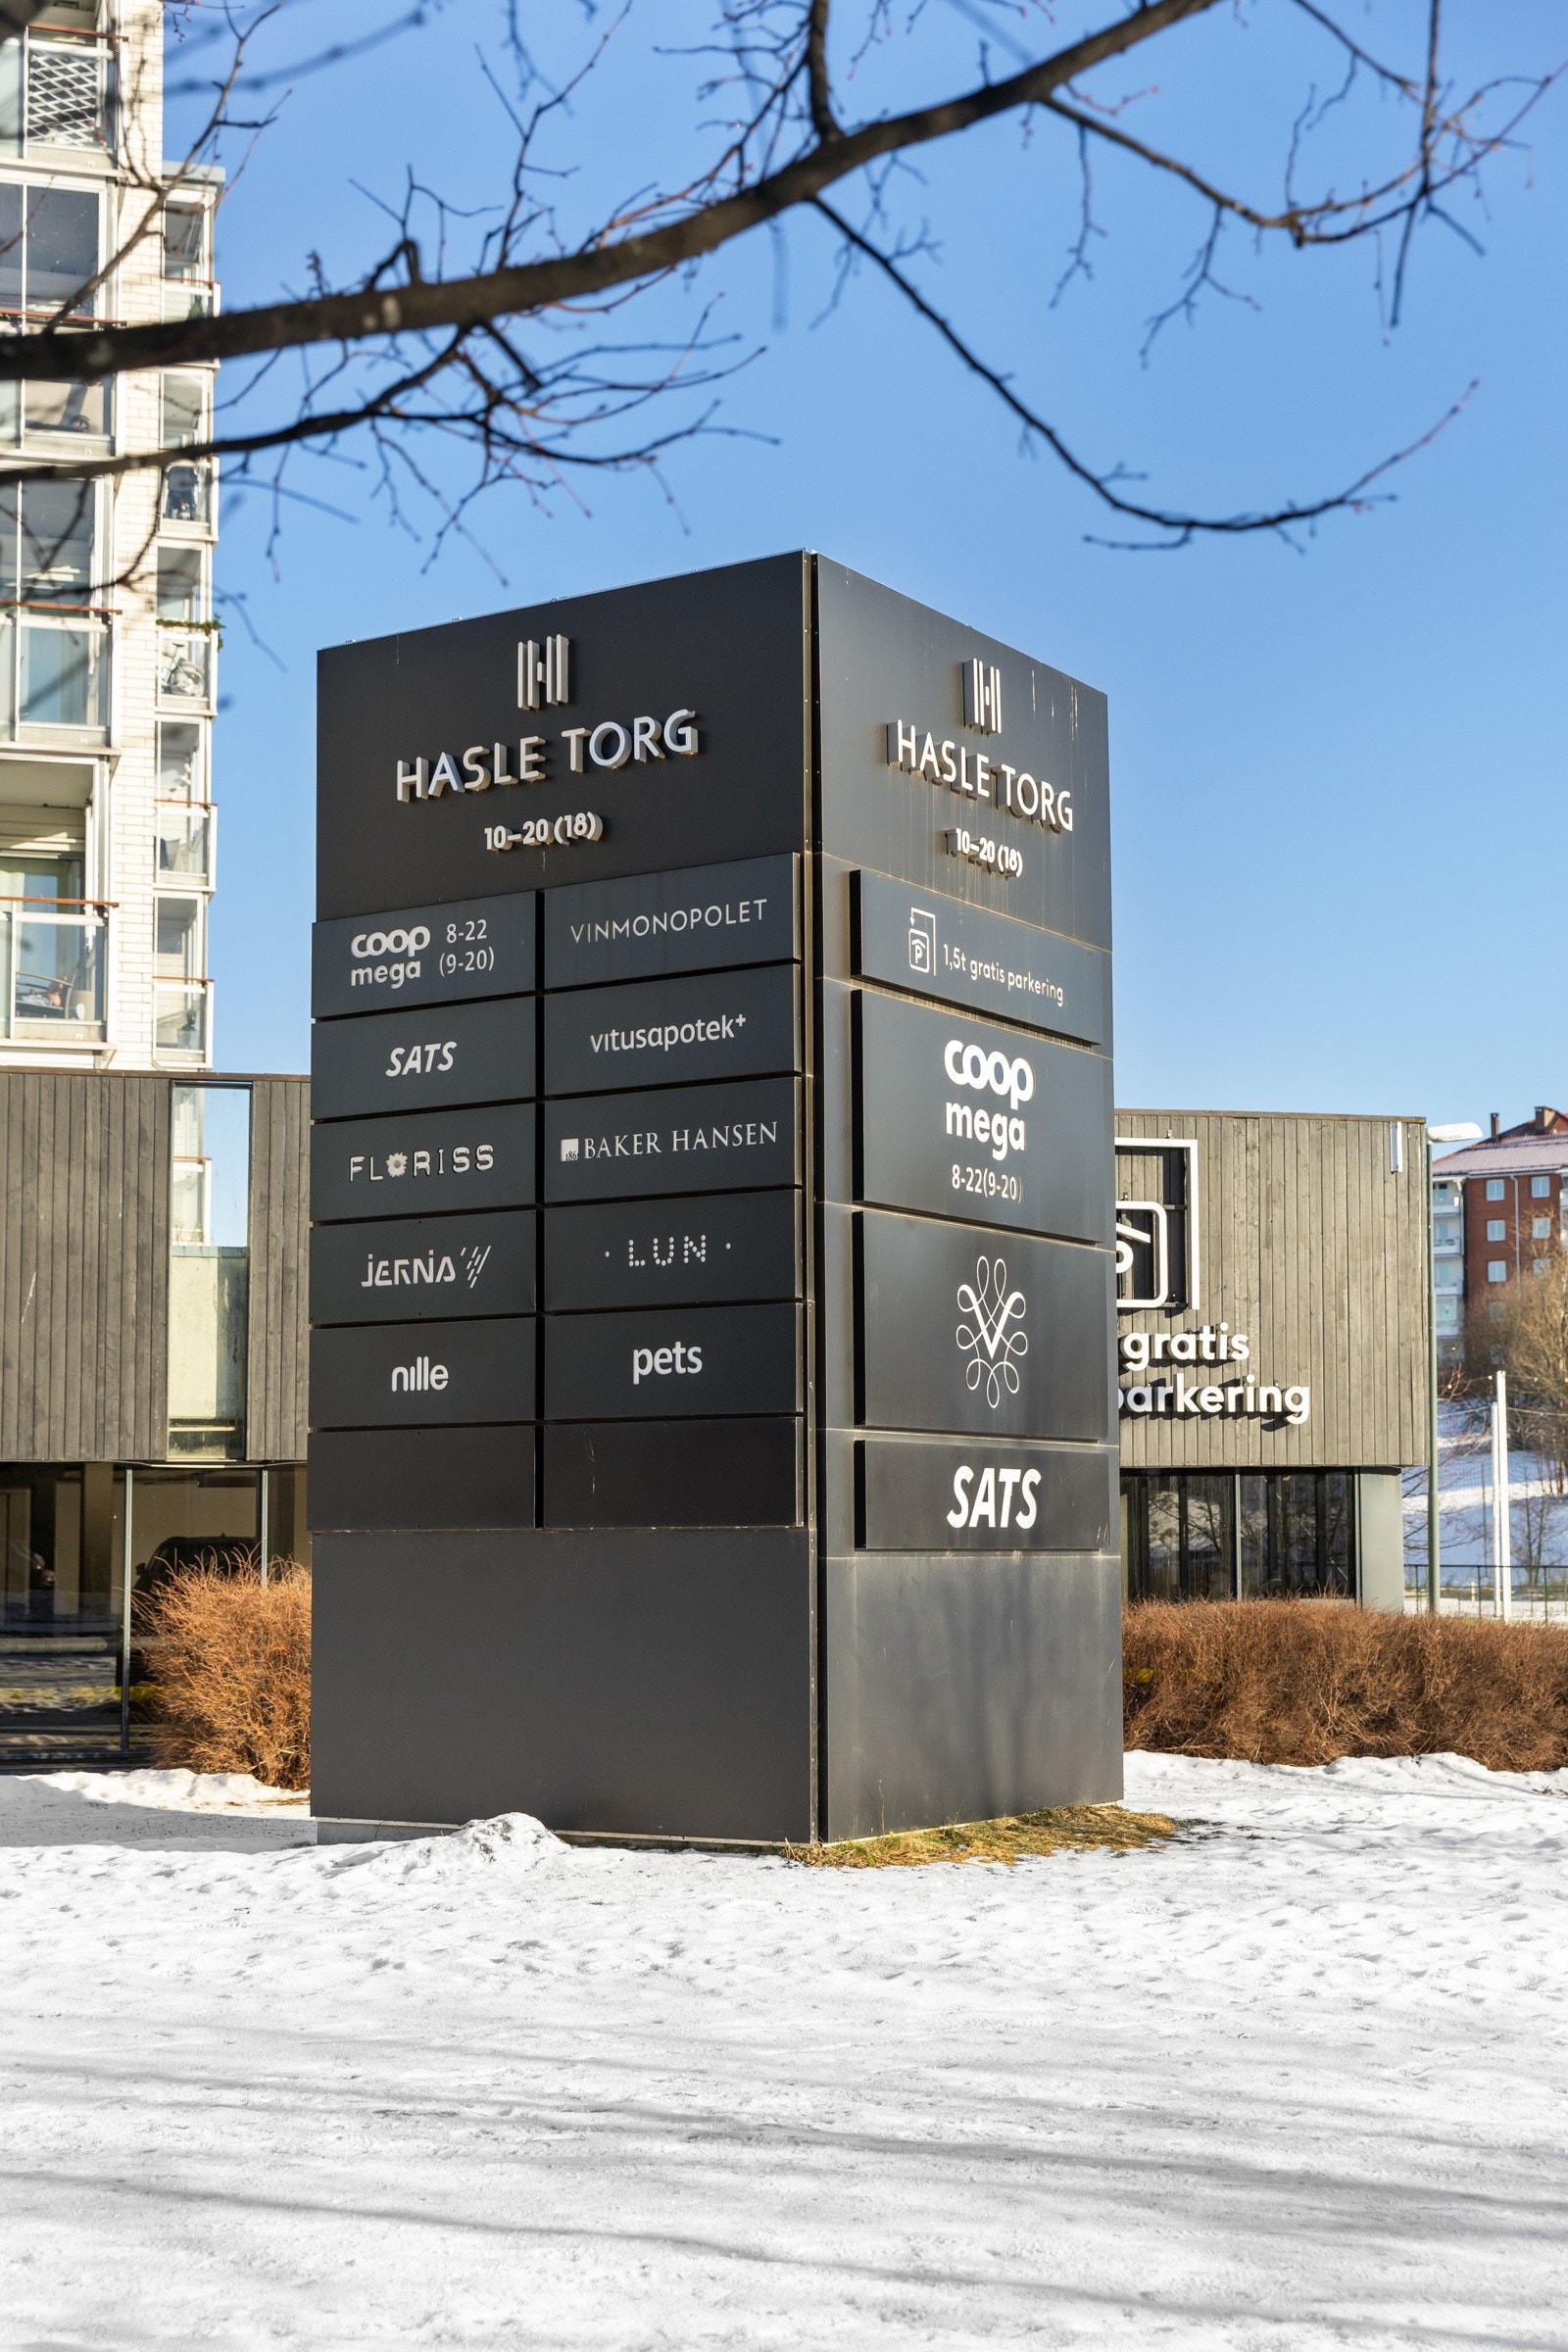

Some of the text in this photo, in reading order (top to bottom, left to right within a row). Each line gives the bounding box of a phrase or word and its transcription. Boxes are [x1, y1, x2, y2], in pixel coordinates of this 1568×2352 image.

[397, 710, 699, 802] HASLE TORG
[896, 719, 1073, 832] HASLE TORG
[553, 811, 603, 846] (18)
[998, 844, 1023, 878] (18)
[446, 919, 487, 944] 8-22
[570, 899, 767, 944] VINMONOPOLET
[351, 926, 431, 958] coop
[351, 960, 421, 990] mega
[439, 947, 495, 977] (9-20)
[944, 944, 1063, 1007] 1,5t gratis parkering
[385, 1041, 457, 1077] SATS
[944, 1040, 1035, 1110] coop
[584, 1121, 778, 1160] BAKER HANSEN
[946, 1102, 1026, 1161] mega
[628, 1234, 707, 1267] LUN
[633, 1341, 703, 1385] pets
[1123, 1322, 1250, 1371] gratis
[392, 1356, 449, 1392] nille
[946, 1465, 1042, 1530] SATS
